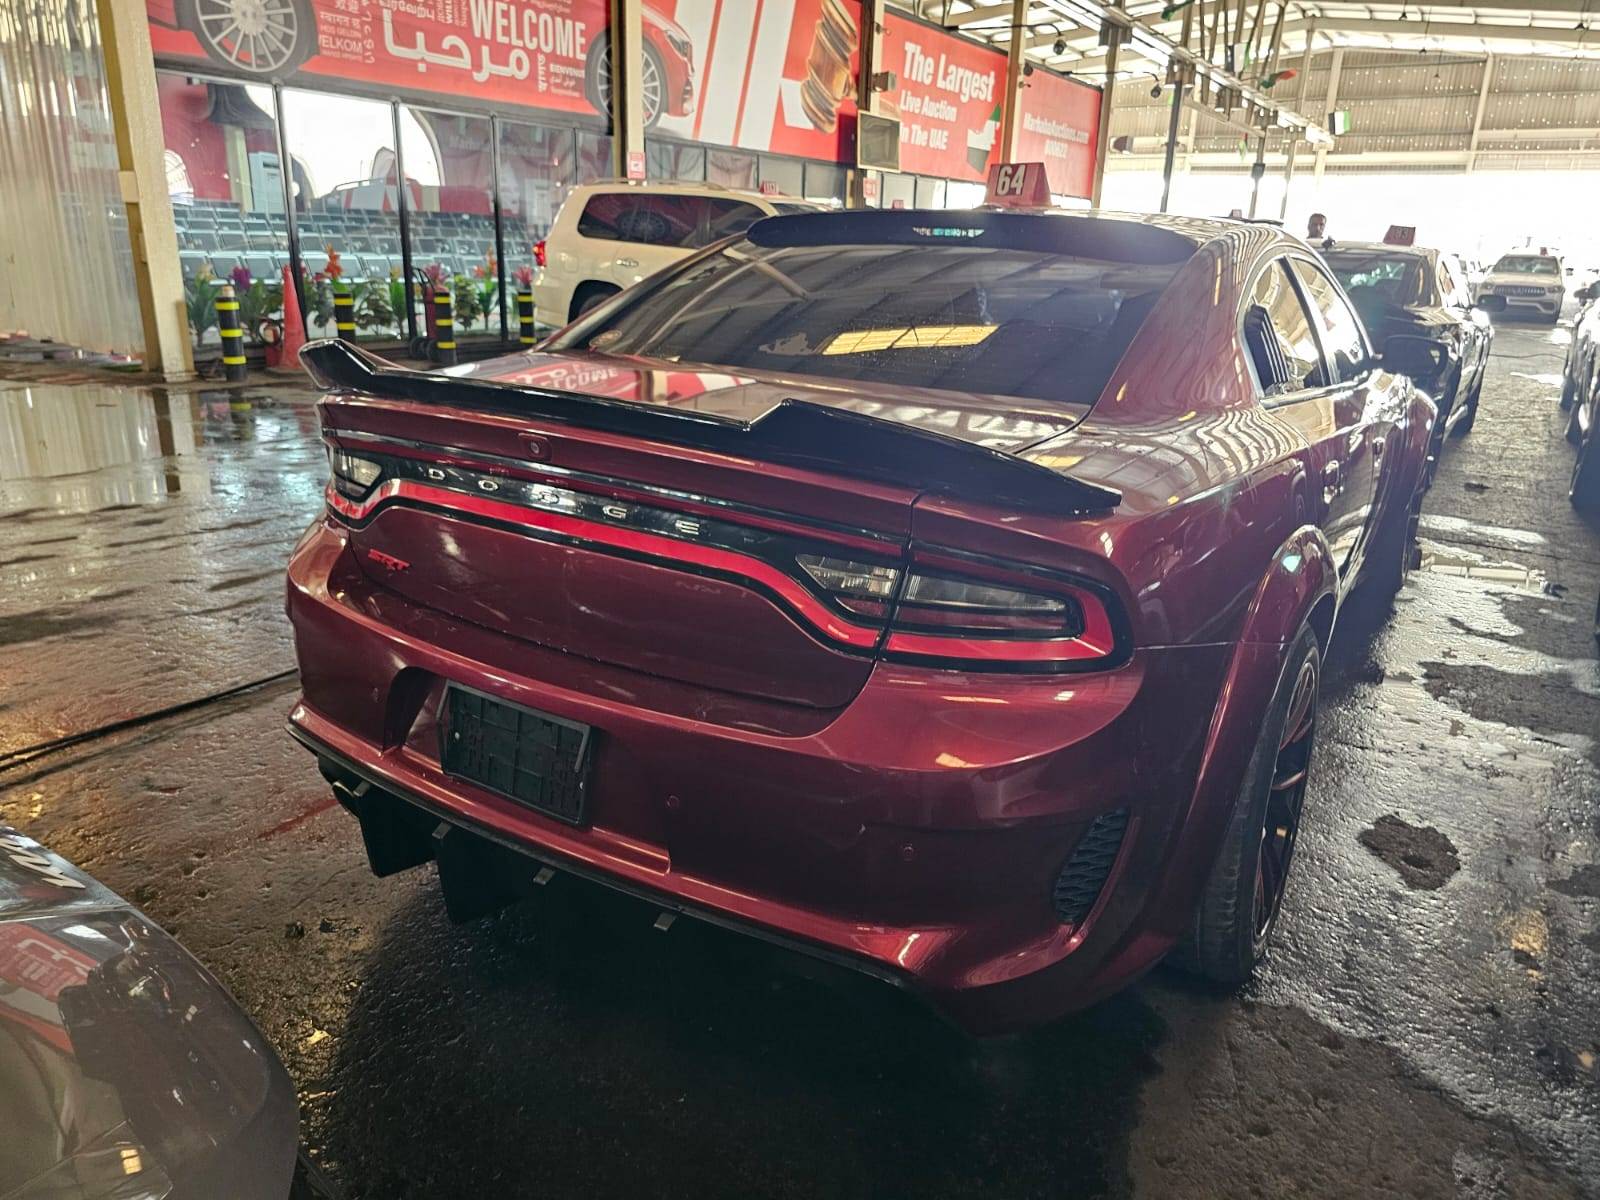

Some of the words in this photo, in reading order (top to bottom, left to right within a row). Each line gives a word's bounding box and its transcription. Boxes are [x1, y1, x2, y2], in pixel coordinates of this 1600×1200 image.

[318, 33, 363, 54] ELKOM
[382, 8, 530, 82] مرحبا
[470, 0, 587, 62] WELCOME
[903, 41, 934, 86] The
[936, 53, 995, 104] Largest
[900, 89, 921, 114] Live
[921, 95, 957, 122] Auction
[911, 123, 928, 147] The
[929, 128, 949, 150] UAE
[995, 164, 1025, 196] 64
[428, 467, 701, 535] DODGE
[368, 549, 411, 571] SRT
